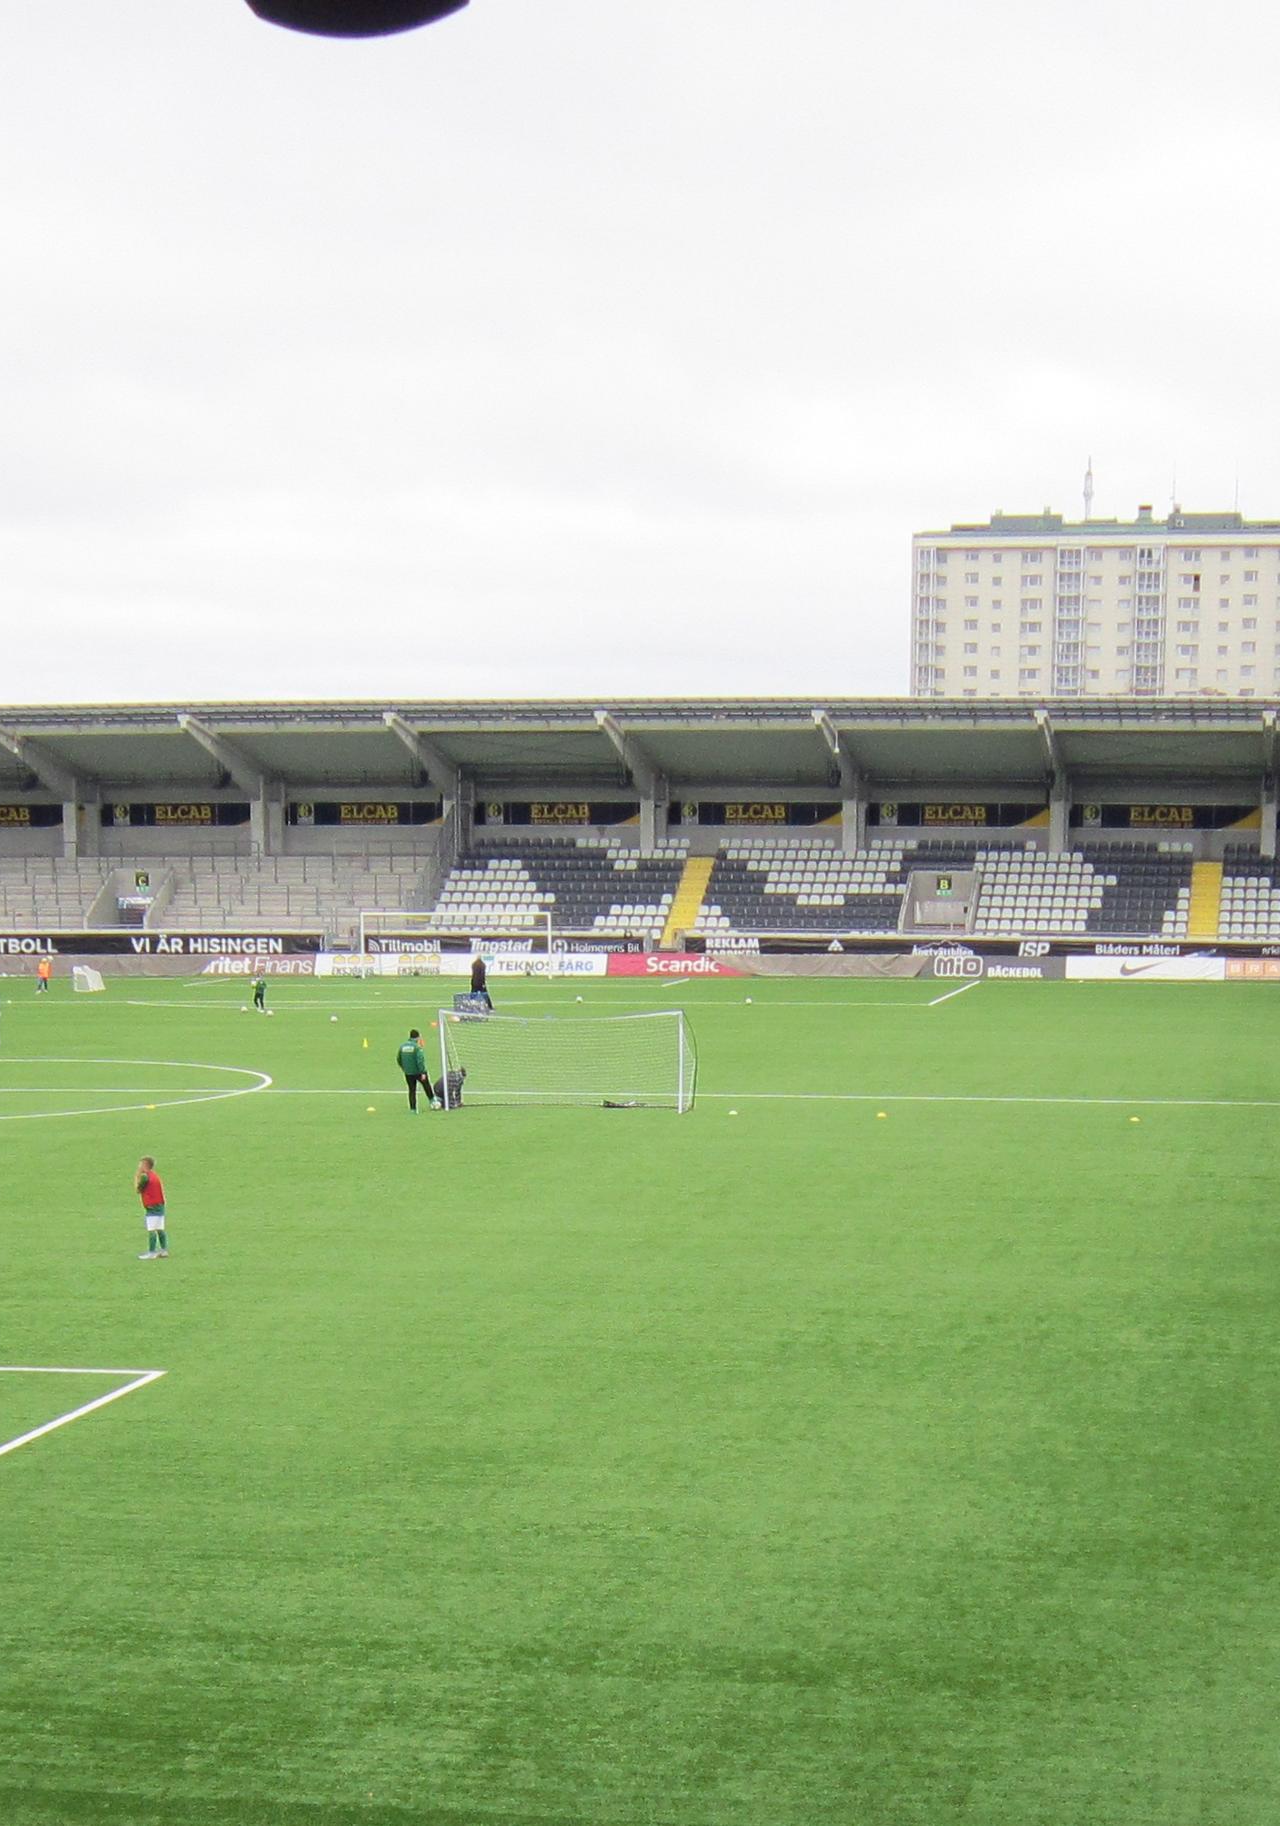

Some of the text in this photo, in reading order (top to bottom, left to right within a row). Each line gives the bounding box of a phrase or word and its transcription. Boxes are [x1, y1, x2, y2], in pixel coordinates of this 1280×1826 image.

[155, 806, 212, 819] ELCAB
[340, 805, 398, 819] ELCAB
[531, 805, 590, 818] ELCAB
[725, 805, 786, 818] ELCAB
[924, 806, 986, 819] ELCAB
[1130, 806, 1194, 820] ELCAB
[940, 879, 949, 890] B
[131, 934, 283, 954] VI ÄR HISINGEN
[379, 939, 441, 953] Tillmobil
[470, 938, 533, 954] Tingstad
[705, 938, 760, 948] REKLAM
[253, 956, 313, 974] Finans
[646, 956, 720, 973] Scandic
[987, 966, 1043, 978] BÄCKEBOL
